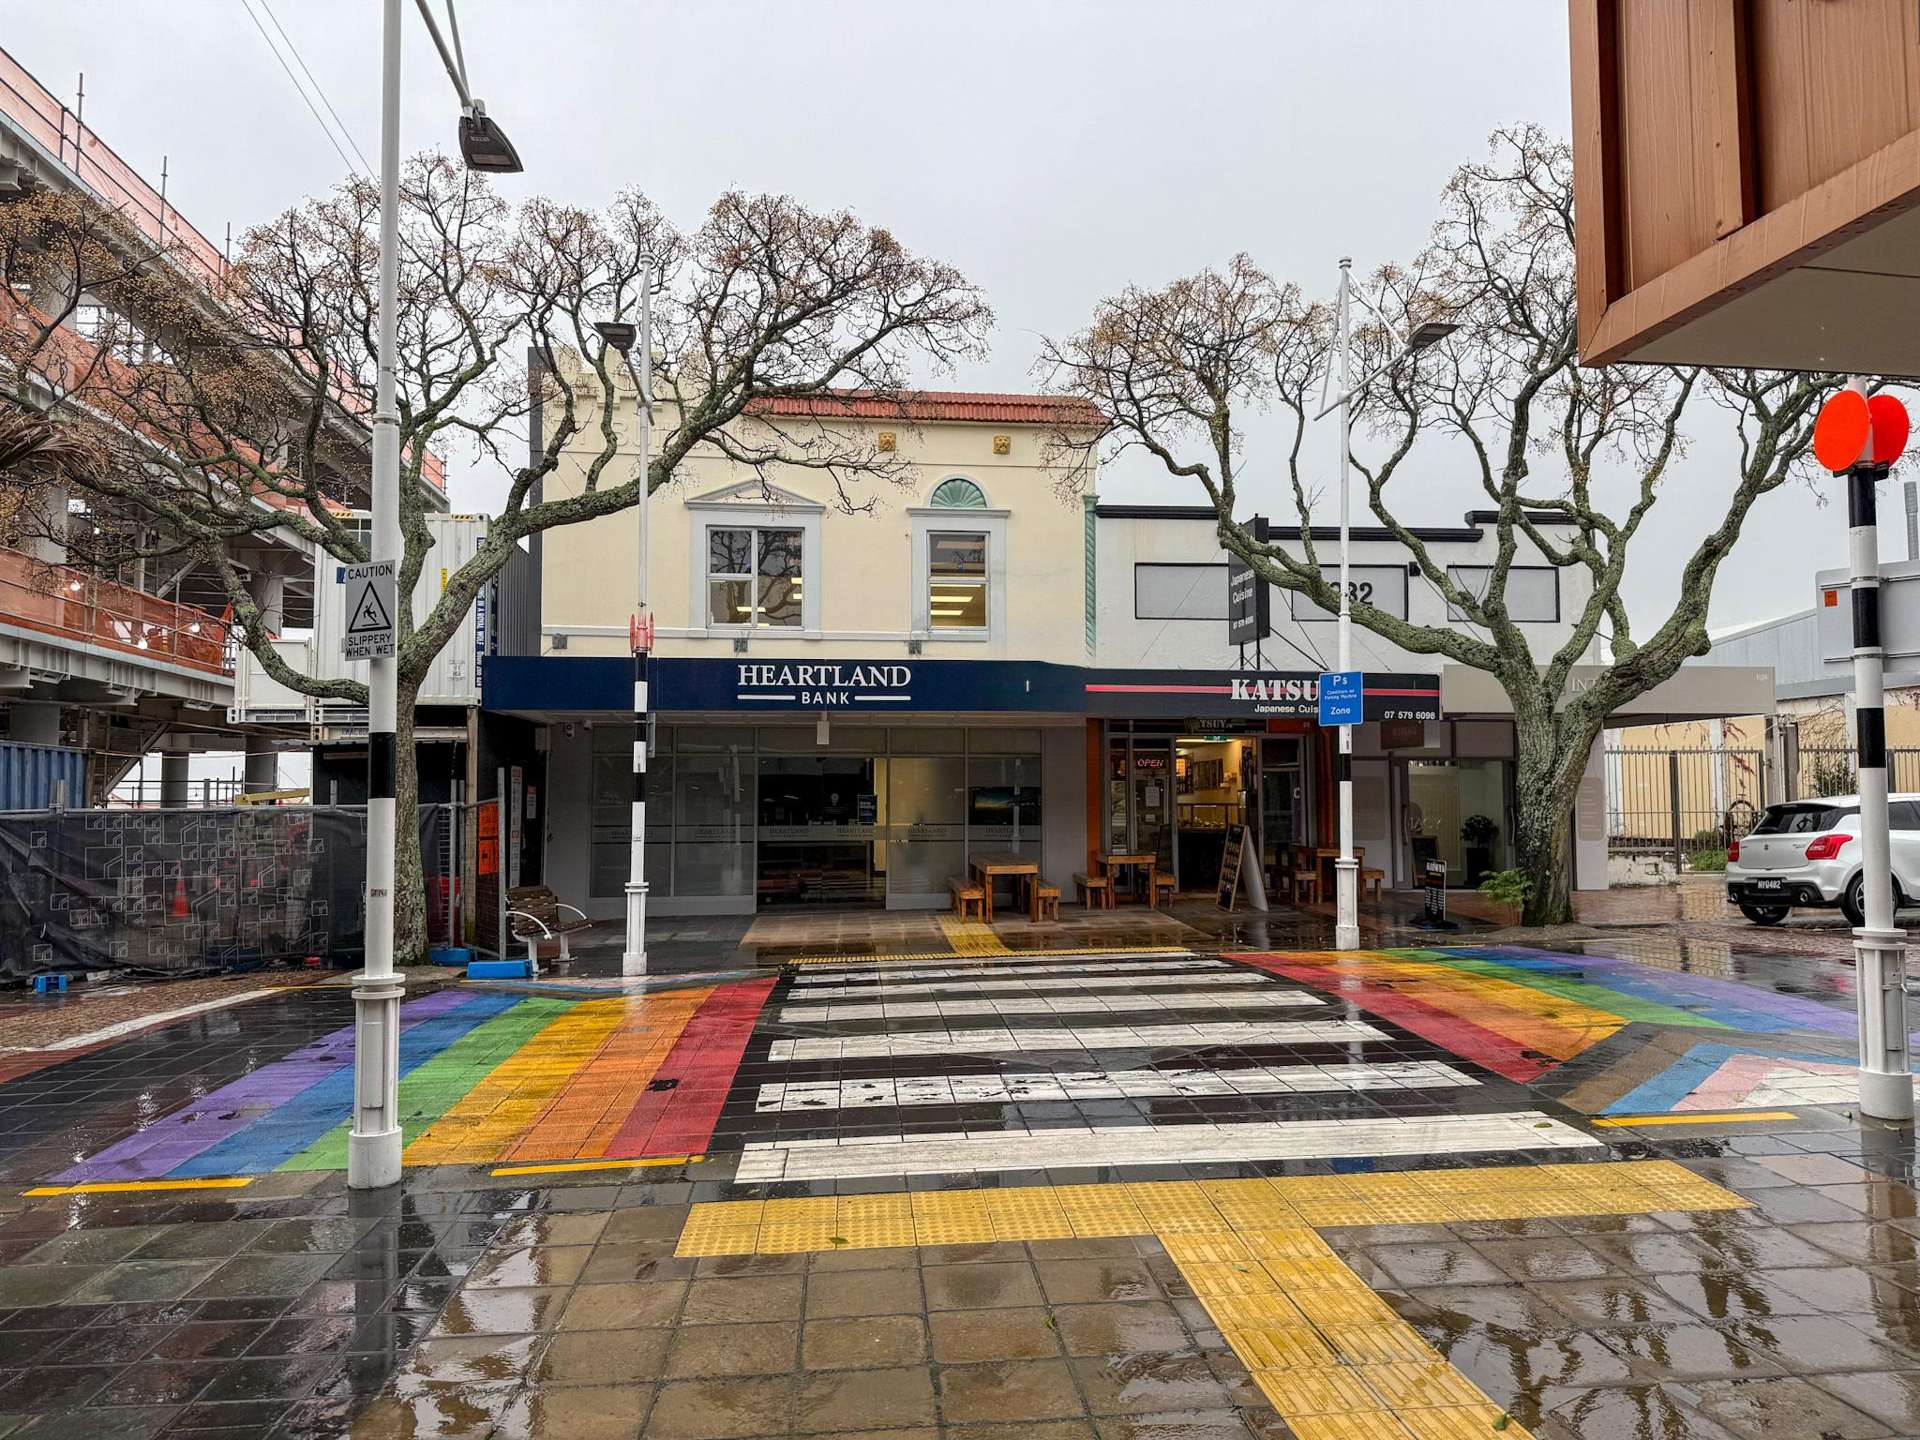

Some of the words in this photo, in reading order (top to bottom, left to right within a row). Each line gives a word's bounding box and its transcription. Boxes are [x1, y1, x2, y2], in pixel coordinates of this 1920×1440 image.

[347, 563, 393, 580] CAUTION
[1230, 568, 1255, 587] Japanese
[1232, 587, 1254, 604] Cuisine
[348, 632, 392, 647] SLIPPERY
[346, 646, 371, 657] WHEN
[375, 643, 395, 655] WET
[737, 664, 911, 687] HEARTLAND
[1231, 679, 1319, 701] KATSU
[801, 691, 850, 705] BANK
[1254, 704, 1296, 713] Japanese
[1298, 704, 1319, 713] Cuis
[1330, 706, 1351, 716] Zone
[1384, 710, 1395, 719] 07
[1398, 711, 1413, 720] 579
[1415, 711, 1436, 720] 6098
[1137, 758, 1164, 768] OPEN
